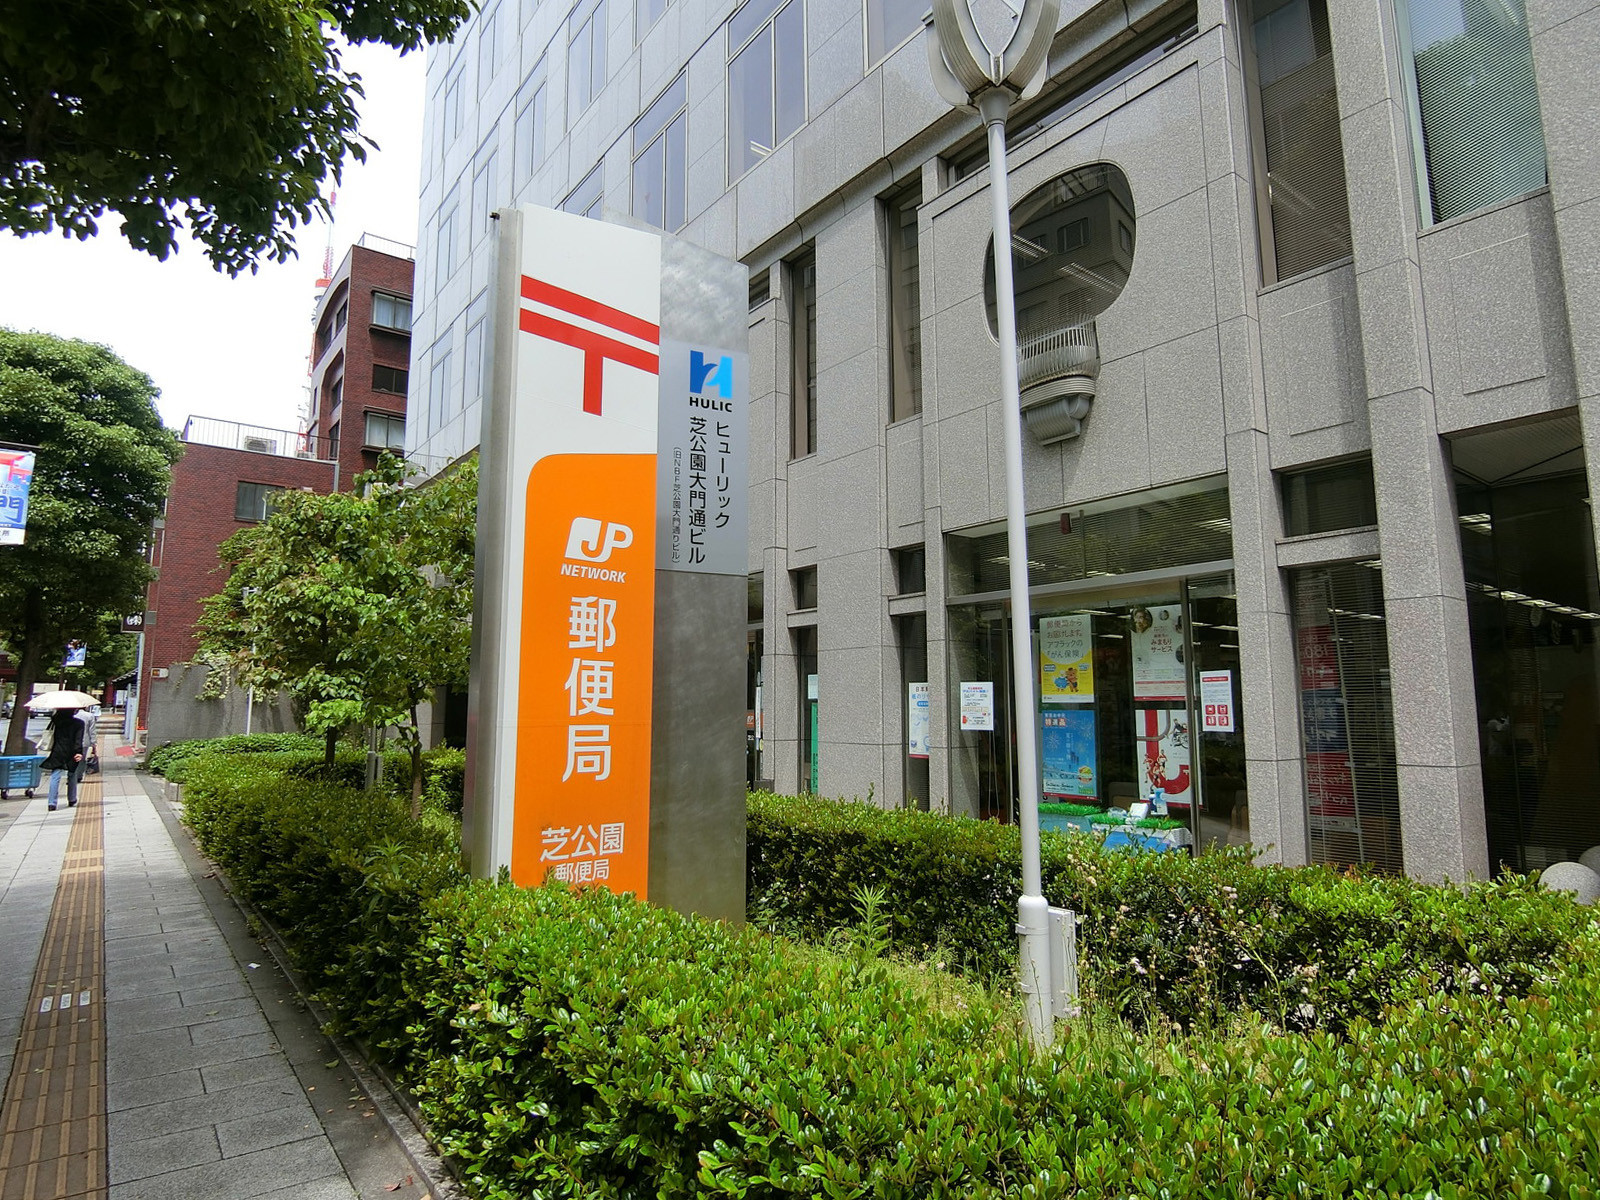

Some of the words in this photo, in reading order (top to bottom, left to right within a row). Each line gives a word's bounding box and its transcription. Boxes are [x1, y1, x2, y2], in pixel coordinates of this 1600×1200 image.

[689, 396, 733, 413] HULIC
[688, 416, 707, 565] 芝公園大門通ビル
[715, 421, 731, 529] ヒューリック
[560, 563, 627, 583] NETWORK
[560, 595, 617, 783] 郵便局
[539, 822, 625, 863] 芝公園
[553, 858, 610, 884] 郵便局
